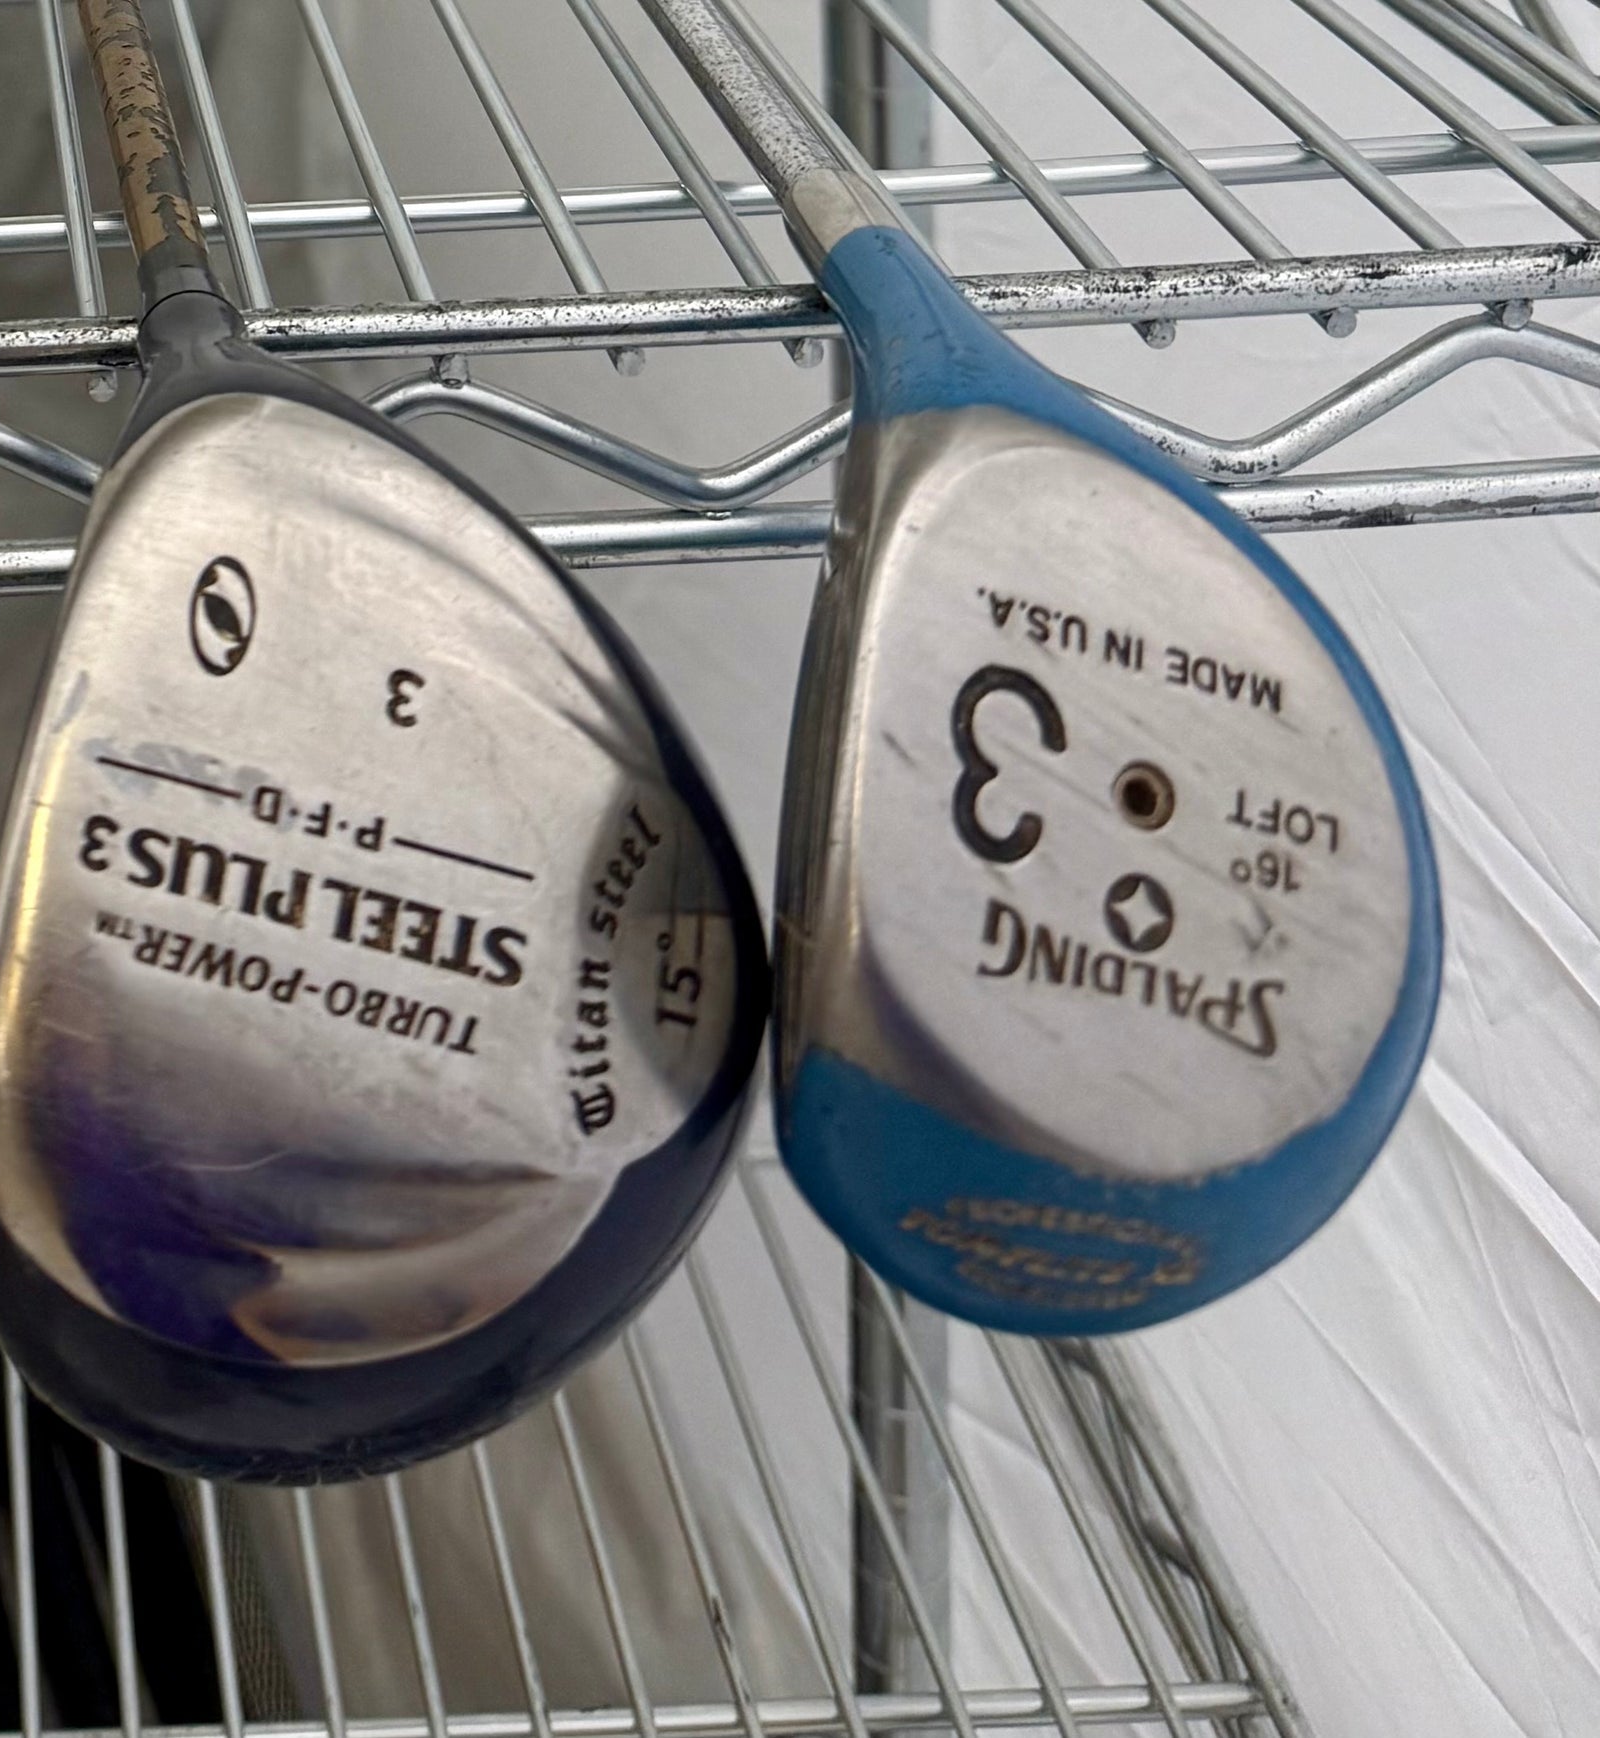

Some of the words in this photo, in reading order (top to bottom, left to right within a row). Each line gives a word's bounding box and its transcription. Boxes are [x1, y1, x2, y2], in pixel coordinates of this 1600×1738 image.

[975, 585, 1090, 653] U.S.A.
[1102, 629, 1146, 668] IN
[385, 668, 427, 728] 3
[1165, 646, 1284, 713] MADE
[950, 664, 1067, 864] 3
[1226, 788, 1341, 853] LOFT
[588, 803, 661, 940] steel
[1230, 851, 1303, 895] 16°
[323, 876, 529, 987] STEEL
[656, 931, 703, 1028] 15°
[976, 897, 1286, 1059] SPALDING
[568, 957, 616, 1136] Titan
